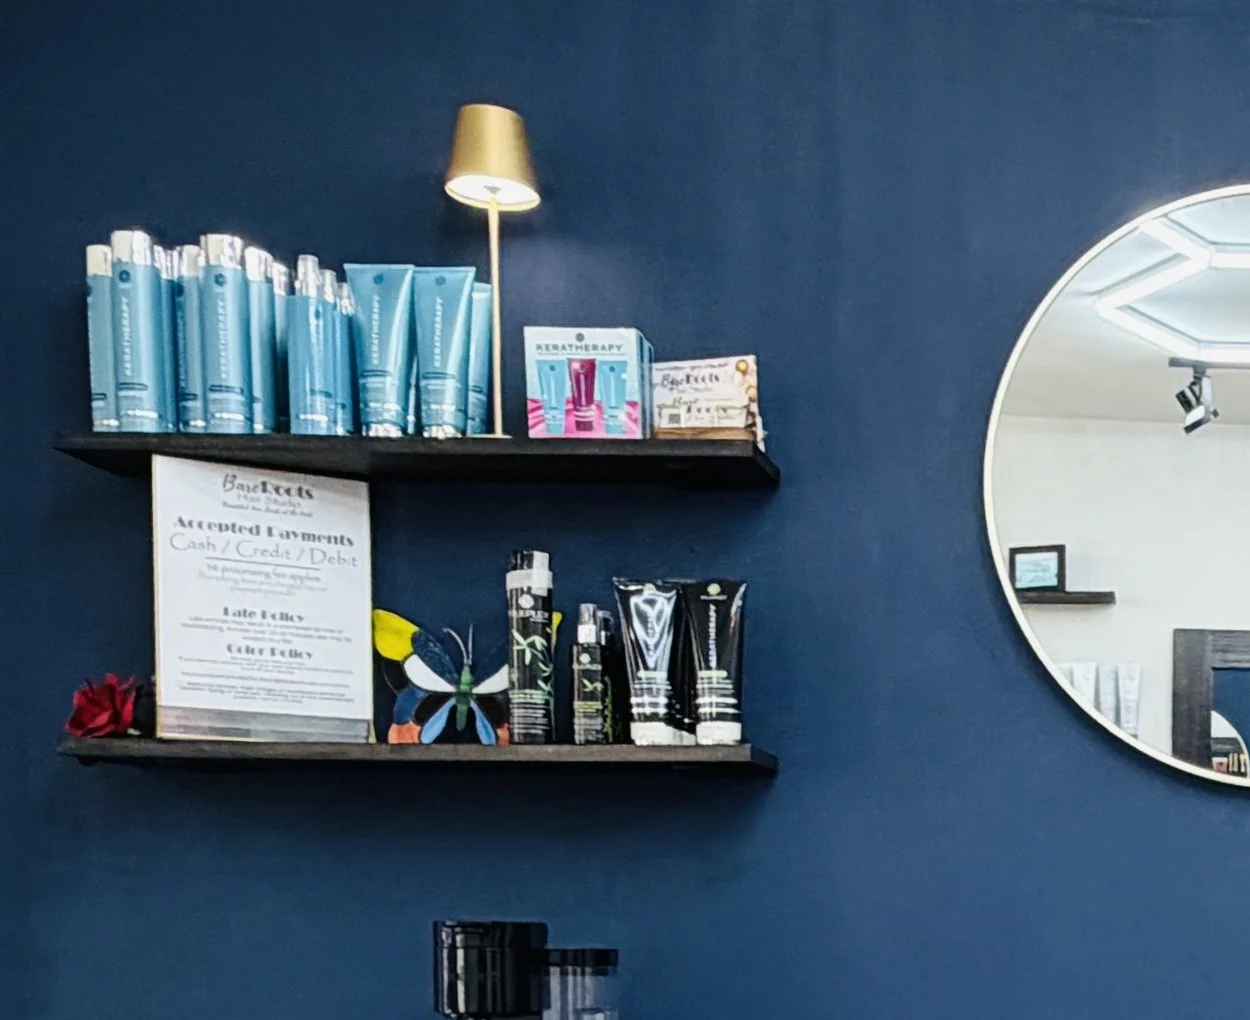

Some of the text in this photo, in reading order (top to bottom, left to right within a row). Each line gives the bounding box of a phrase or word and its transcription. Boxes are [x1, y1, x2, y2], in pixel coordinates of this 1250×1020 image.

[535, 343, 624, 353] KERATHERAPY
[174, 516, 354, 547] Accepted Payments
[170, 532, 216, 551] Cash
[236, 540, 291, 561] Credit
[310, 547, 358, 568] Debit
[223, 606, 305, 623] Late Policy
[226, 643, 314, 660] Color Policy
